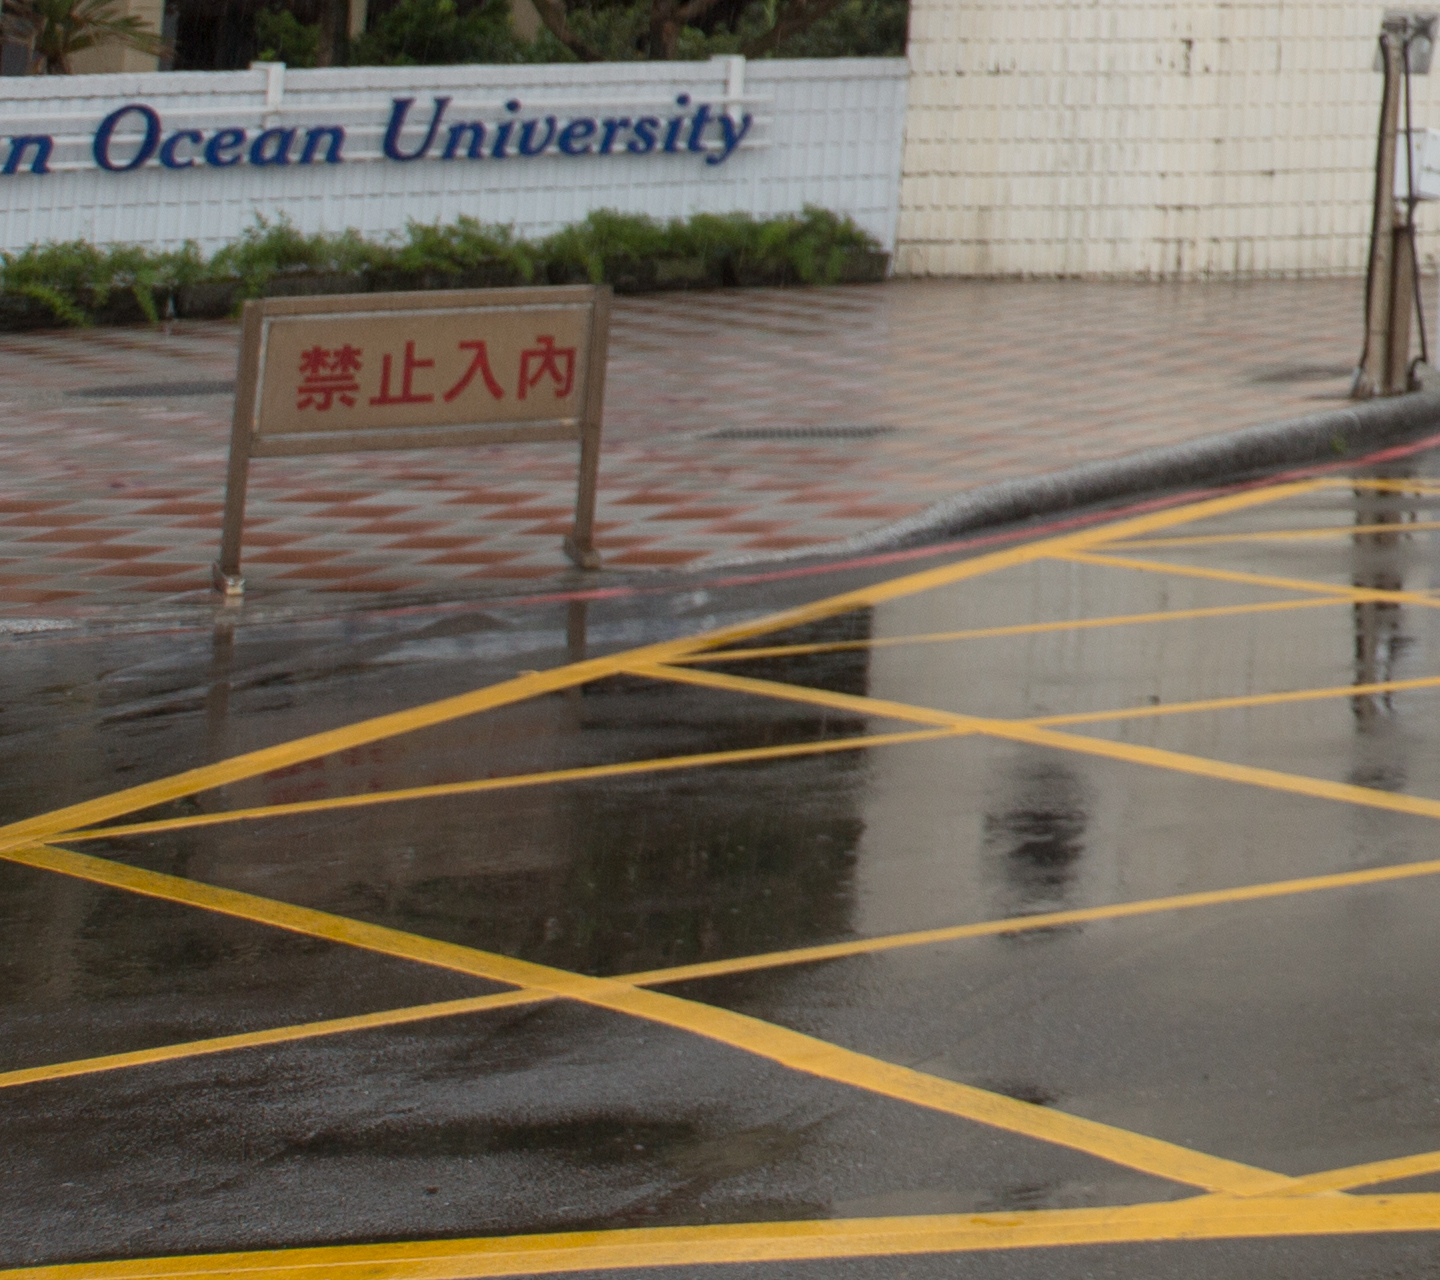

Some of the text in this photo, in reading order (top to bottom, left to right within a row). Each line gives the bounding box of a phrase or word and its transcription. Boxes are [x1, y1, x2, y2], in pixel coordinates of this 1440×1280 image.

[91, 104, 345, 174] Ocean
[382, 95, 753, 167] University
[297, 334, 577, 412] 禁止入內
